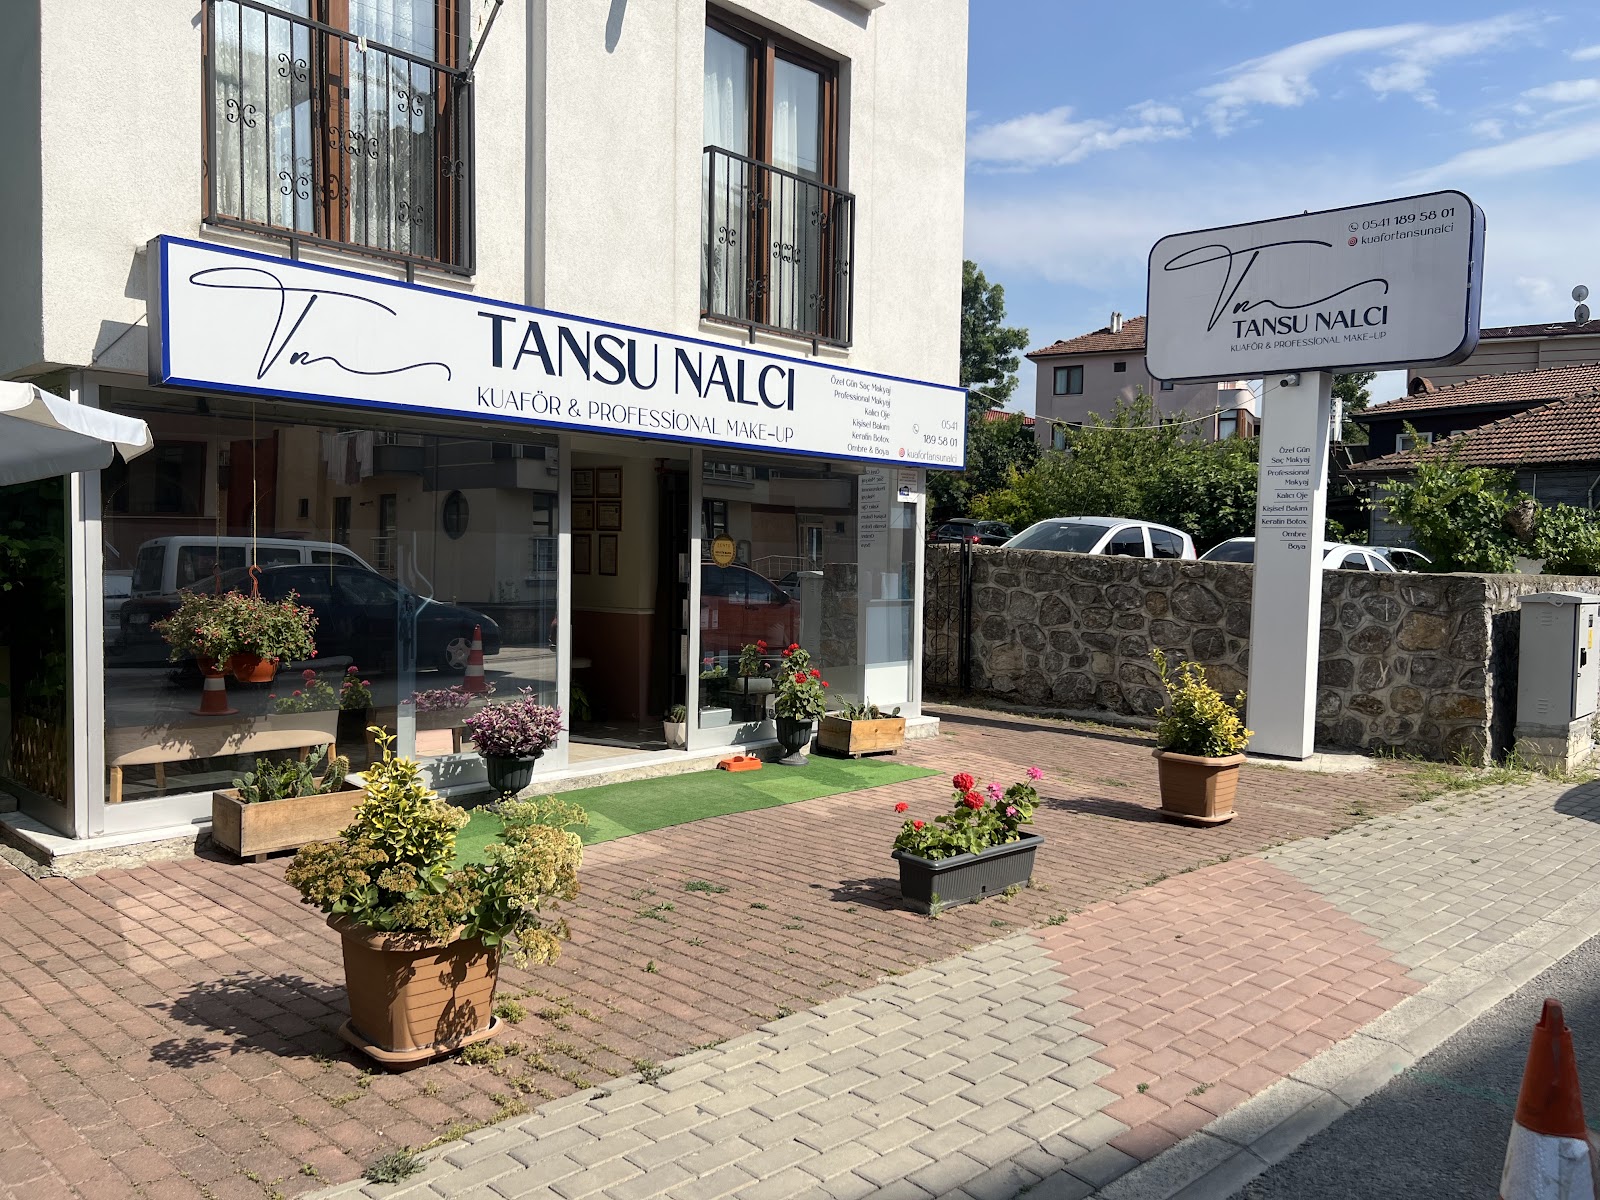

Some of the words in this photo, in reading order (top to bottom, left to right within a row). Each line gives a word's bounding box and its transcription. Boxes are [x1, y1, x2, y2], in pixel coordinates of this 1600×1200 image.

[1362, 218, 1390, 230] 0541
[1394, 213, 1416, 225] 189
[1420, 210, 1437, 221] 58
[1441, 207, 1455, 218] 01
[1361, 222, 1454, 245] kuafortansunalci
[1232, 314, 1308, 340] TANSU
[1315, 305, 1388, 332] NALCI
[1230, 342, 1264, 352] KUAFÖR
[1265, 342, 1272, 350] &
[1274, 335, 1340, 348] PROFESSİONAL
[1343, 331, 1387, 343] MAKE-UP
[477, 311, 658, 391] TANSU
[674, 347, 795, 411] NALCI
[830, 374, 845, 386] Özel
[845, 378, 858, 388] Gün
[859, 380, 870, 392] Saç
[871, 383, 891, 396] Makyaj
[834, 389, 870, 403] Professional
[871, 395, 891, 409] Makyaj
[477, 386, 561, 416] KUAFÖR
[568, 398, 581, 417] &
[588, 400, 721, 436] PROFESSİONAL
[726, 419, 794, 443] MAKE-UP
[864, 407, 880, 417] Kalıcı
[880, 410, 891, 420] Oje
[852, 418, 871, 429] Kişisel
[872, 421, 890, 431] Bakım
[941, 419, 958, 431] 0541
[852, 431, 872, 441] Keratin
[873, 433, 890, 444] Botox
[923, 434, 936, 445] 189
[937, 436, 948, 446] 58
[949, 437, 958, 447] 01
[847, 443, 868, 453] Ombre
[874, 446, 890, 456] Boya
[906, 448, 958, 463] kuafortansunalci
[1279, 446, 1294, 454] Özel
[1285, 456, 1310, 464] Makyaj
[1296, 492, 1308, 500] Oje
[1262, 505, 1284, 513] Kişisel
[1287, 543, 1306, 551] Boya
